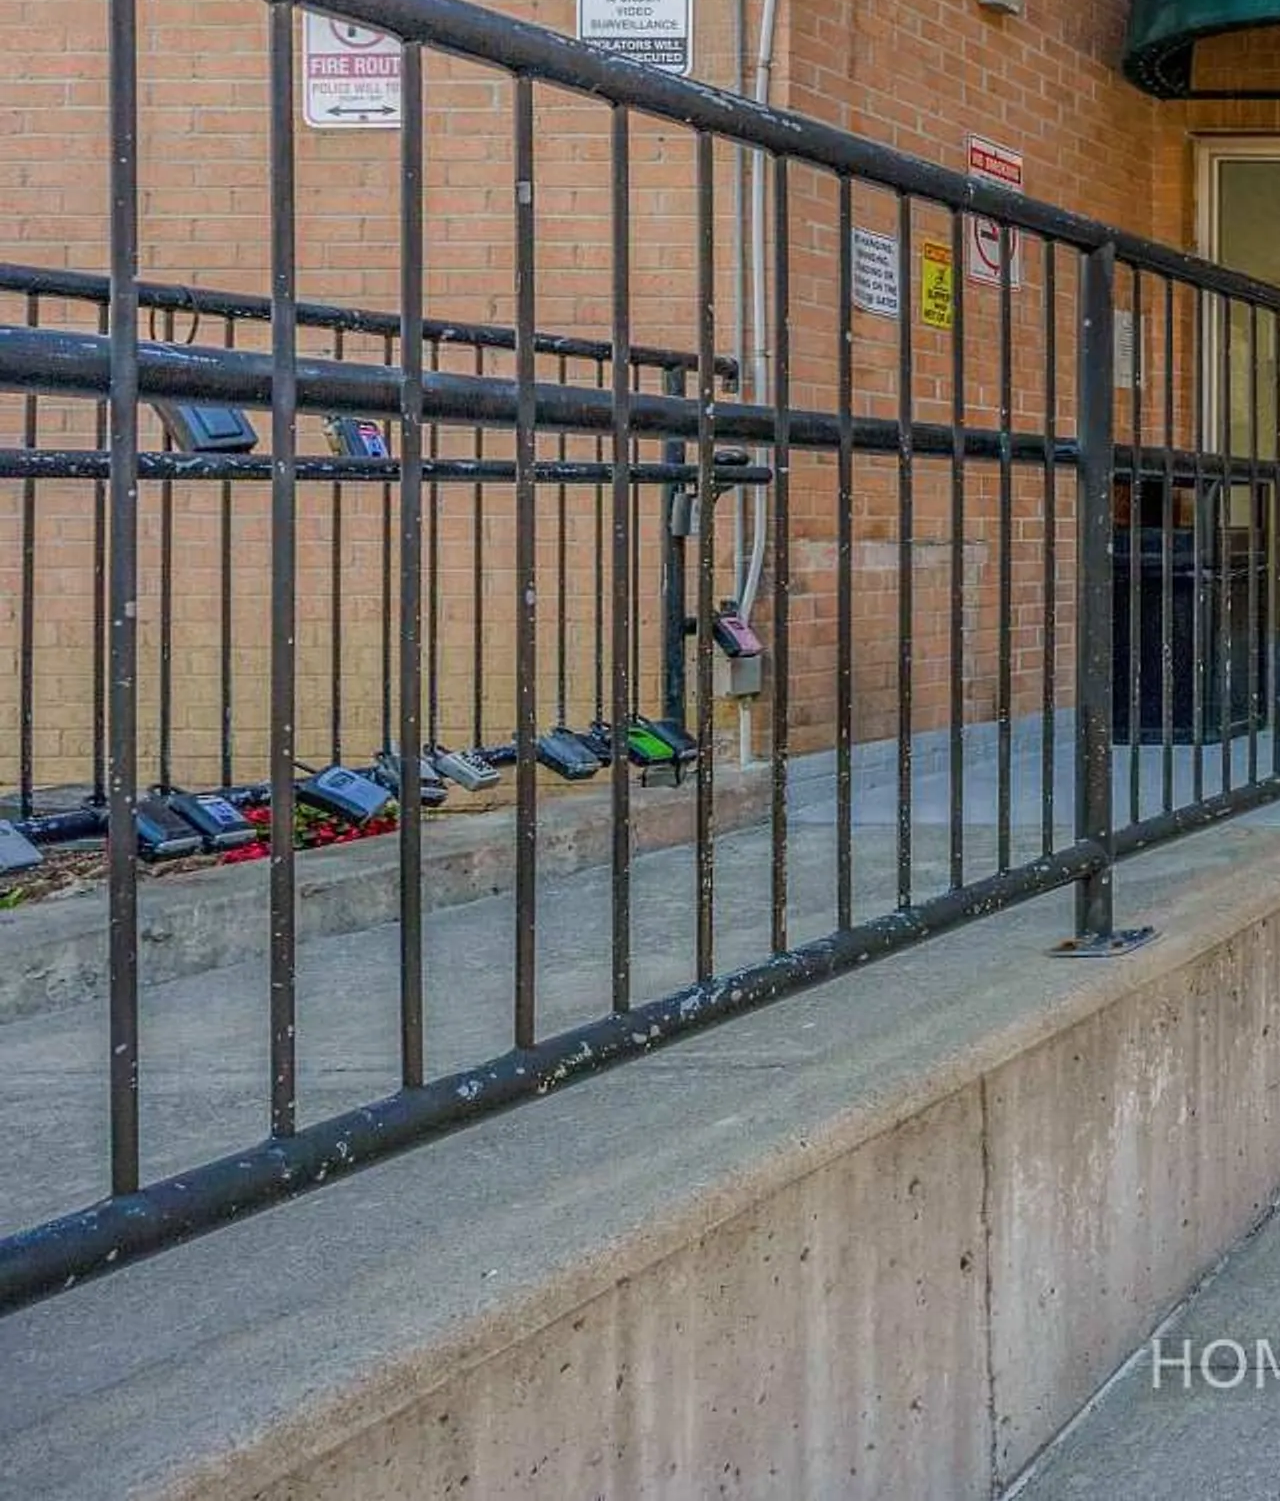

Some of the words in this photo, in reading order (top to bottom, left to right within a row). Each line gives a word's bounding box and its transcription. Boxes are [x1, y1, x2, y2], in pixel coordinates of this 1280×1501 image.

[616, 6, 654, 17] VIDEO
[589, 19, 680, 31] SURVEILLANCE
[653, 39, 684, 50] WILL
[310, 57, 349, 75] FIRE
[354, 57, 401, 75] ROUT
